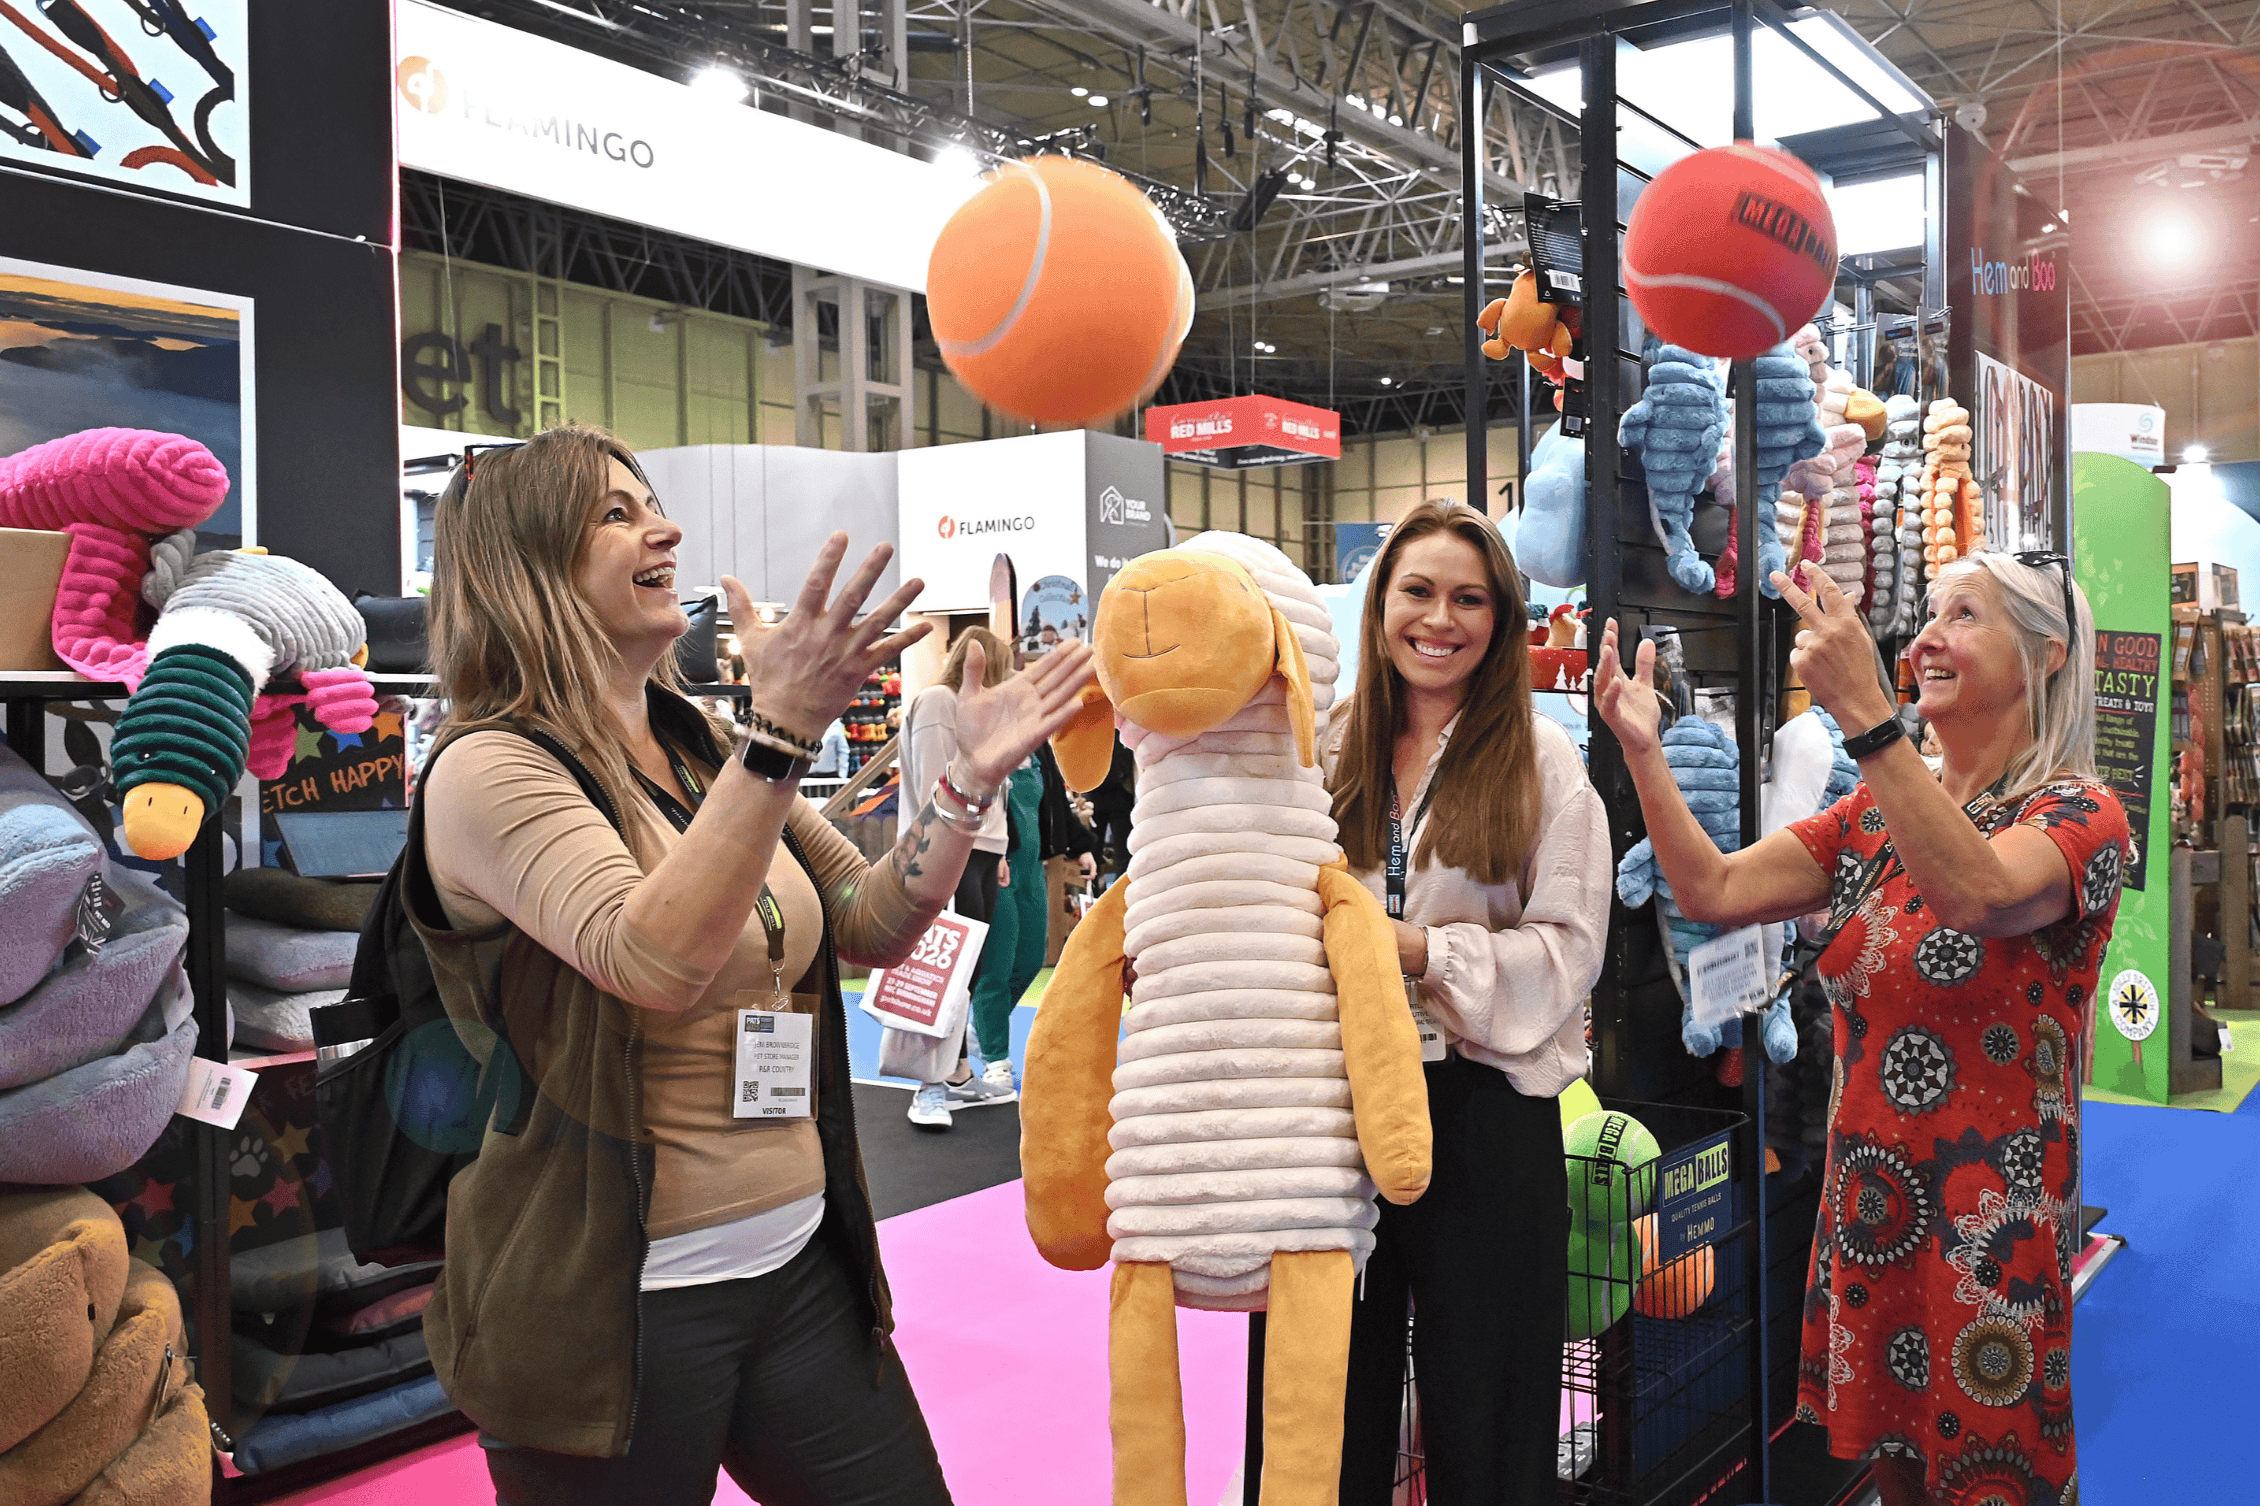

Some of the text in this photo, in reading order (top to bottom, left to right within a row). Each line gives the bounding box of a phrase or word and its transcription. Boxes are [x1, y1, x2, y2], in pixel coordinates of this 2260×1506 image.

[463, 90, 654, 169] FLAMINGO
[1971, 247, 2056, 295] Hem and Boo
[1170, 419, 1233, 439] RED MILLS
[1281, 420, 1297, 434] RED
[1298, 424, 1320, 440] MILLS
[959, 515, 1035, 536] FLAMINGO
[2114, 636, 2159, 658] GOOD
[2095, 669, 2155, 698] TASTY
[2134, 701, 2154, 713] TOYS
[330, 752, 405, 793] HAPPY
[1391, 822, 1400, 843] and
[1387, 845, 1401, 876] Hem
[922, 923, 962, 952] ATS
[911, 939, 952, 970] 026
[2114, 1015, 2154, 1039] COMPANY
[762, 1107, 786, 1115] VISITOR
[1601, 1115, 1627, 1143] MEGA
[1664, 1147, 1728, 1200] MEGA BALLS
[1671, 1192, 1722, 1223] QUALITY TENNIS BALLS
[1687, 1216, 1715, 1242] HEMMO
